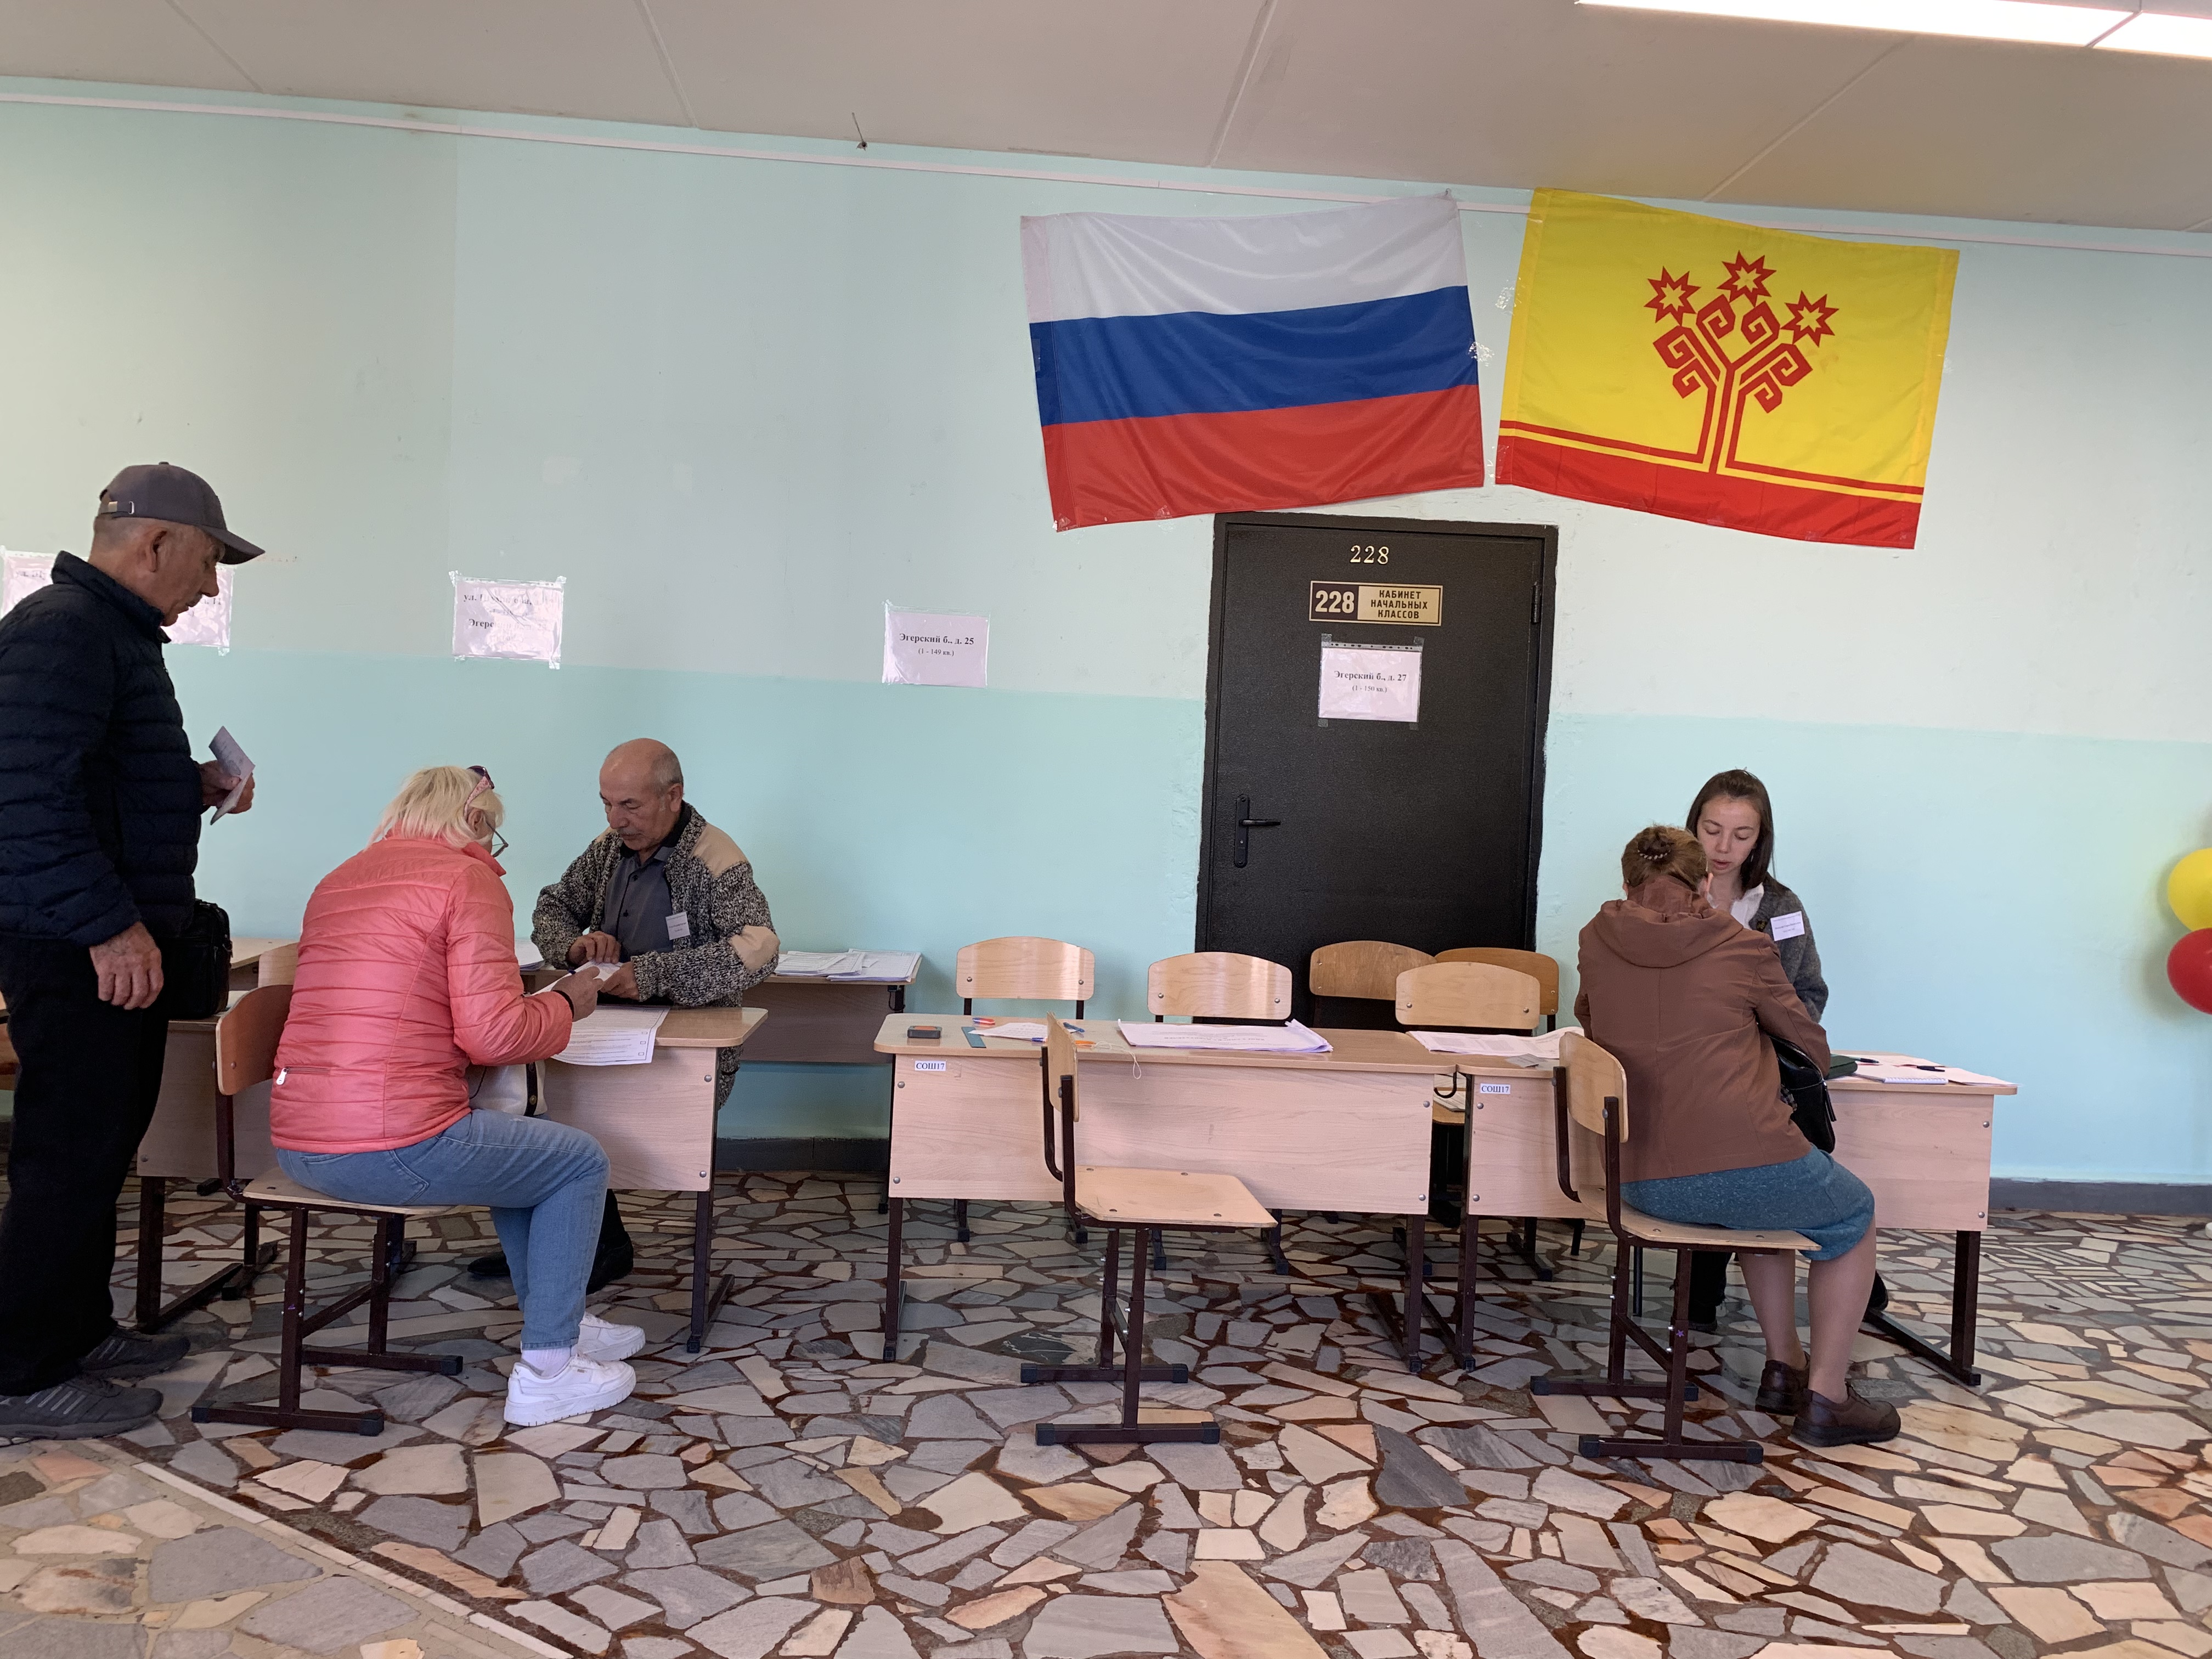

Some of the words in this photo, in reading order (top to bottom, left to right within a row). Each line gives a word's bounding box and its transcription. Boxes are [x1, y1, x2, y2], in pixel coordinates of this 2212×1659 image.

[1350, 545, 1389, 565] 228
[464, 594, 477, 602] ул.
[1379, 590, 1421, 600] КАБИНЕТ
[1315, 590, 1355, 613] 228
[1371, 600, 1427, 610] НАЧАЛЬНЫХ
[1378, 610, 1419, 619] КЛАССОВ
[900, 633, 940, 643] Эгерский
[1334, 670, 1374, 680] Эгерский
[1376, 673, 1386, 681] б.,
